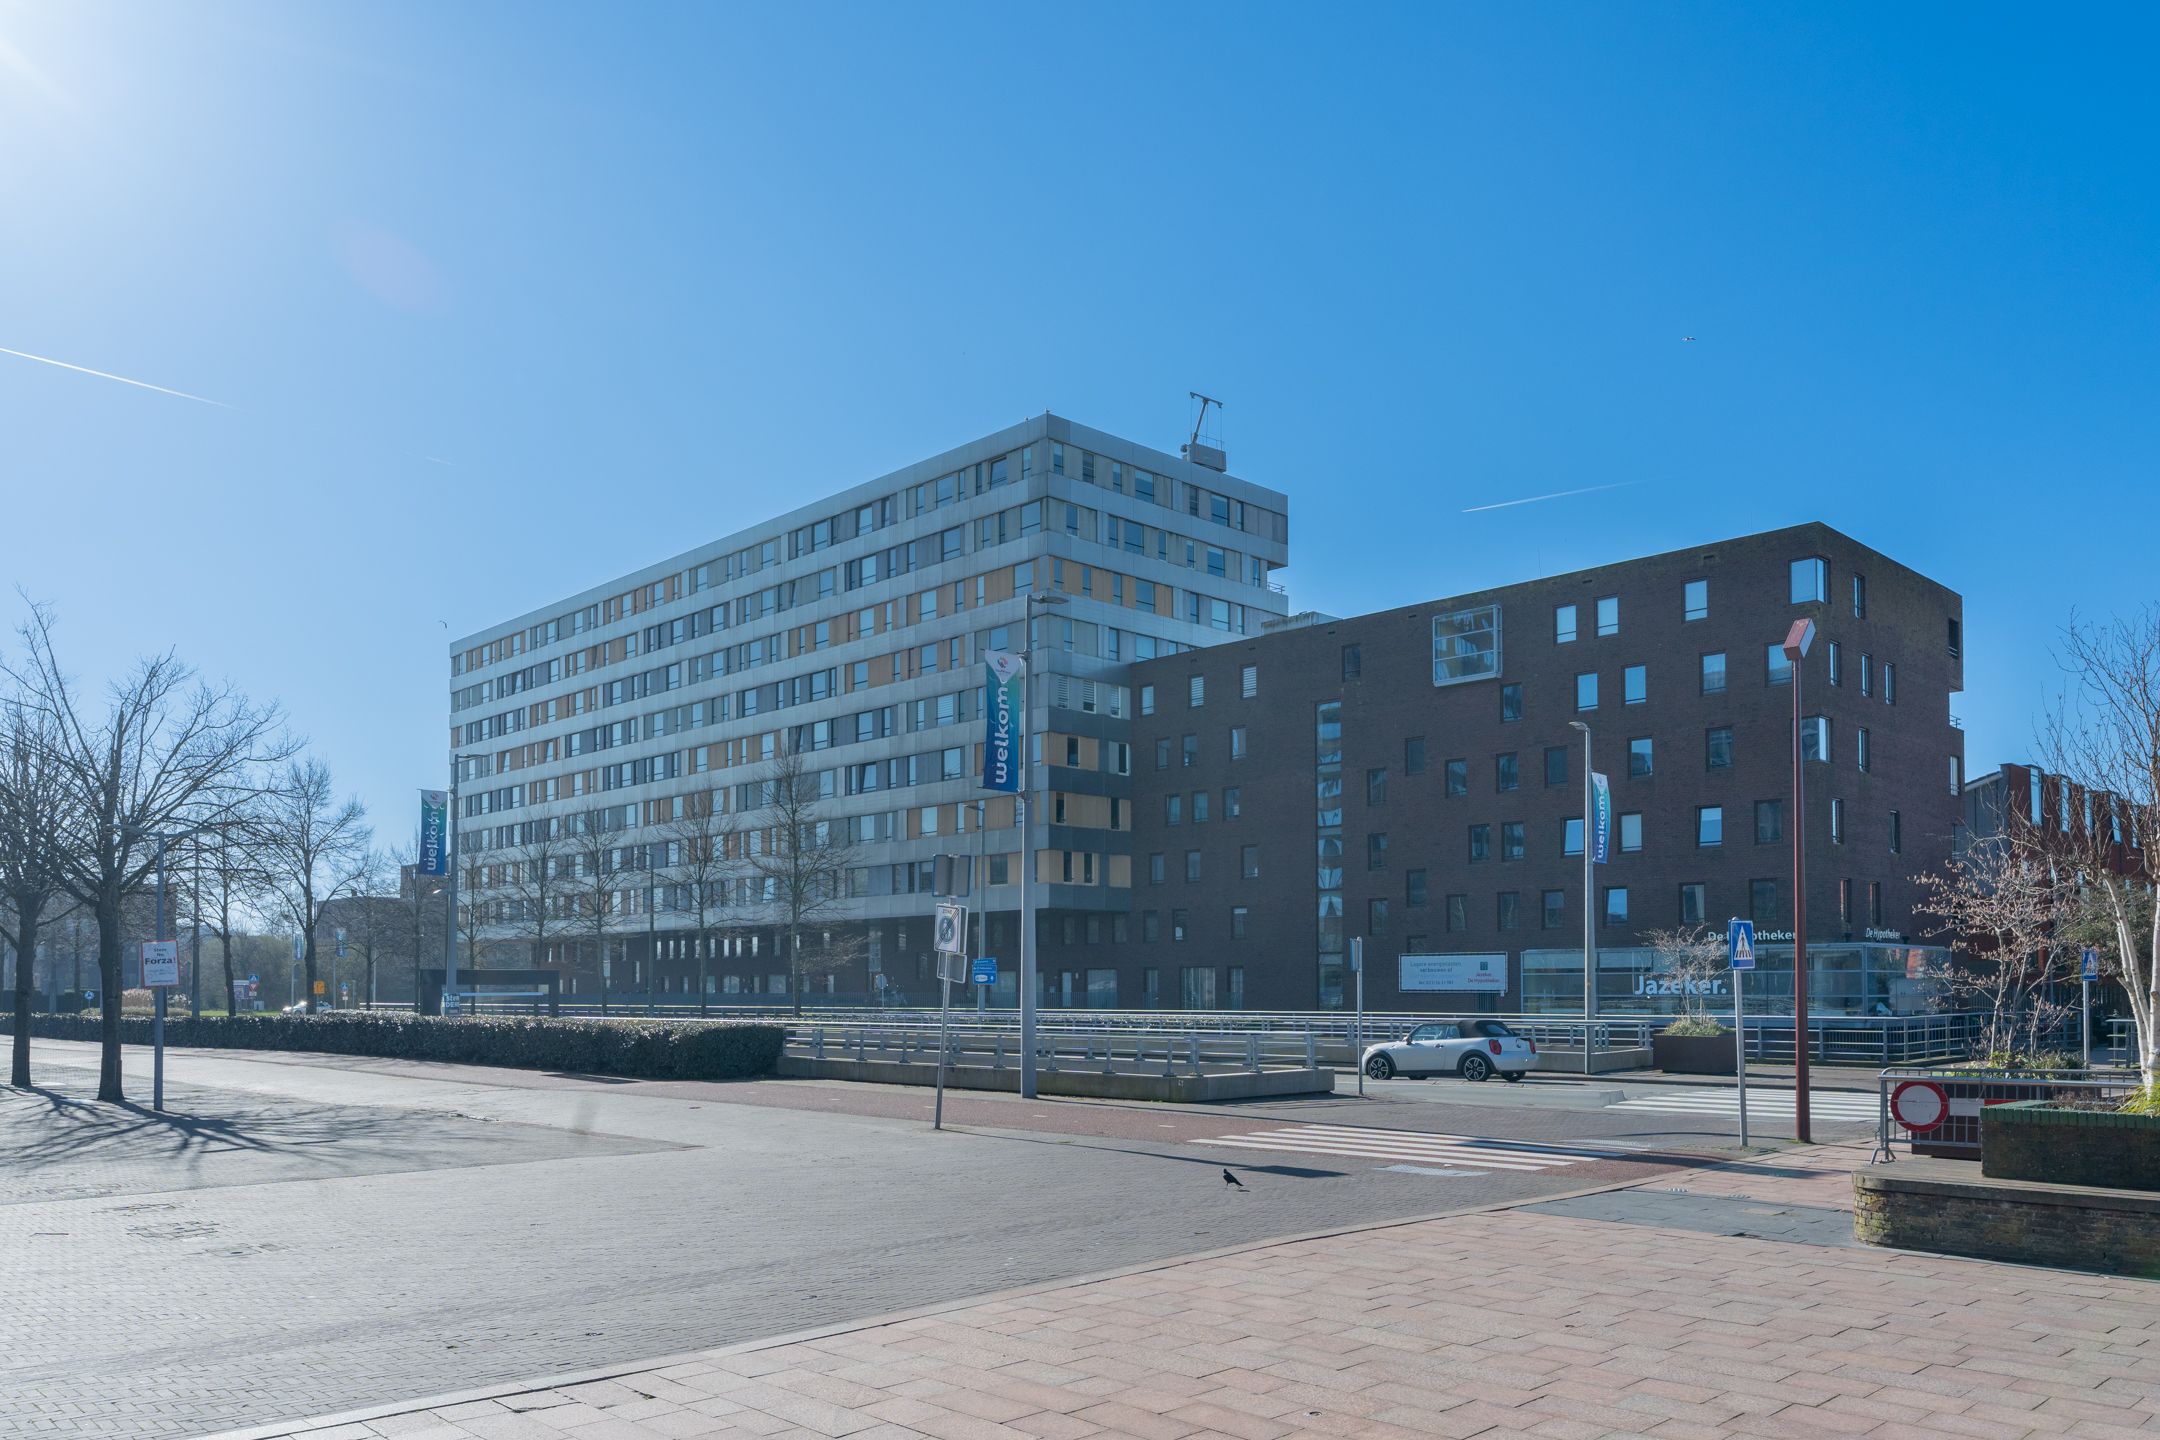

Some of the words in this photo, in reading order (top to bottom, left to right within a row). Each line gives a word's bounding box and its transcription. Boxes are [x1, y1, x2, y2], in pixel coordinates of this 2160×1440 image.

[995, 684, 1009, 784] welkom
[1597, 795, 1605, 858] welkom
[427, 811, 439, 871] welkom
[1707, 931, 1724, 942] De
[1865, 927, 1873, 938] De
[145, 957, 176, 965] Forza!
[1635, 975, 1727, 995] Jazeker.
